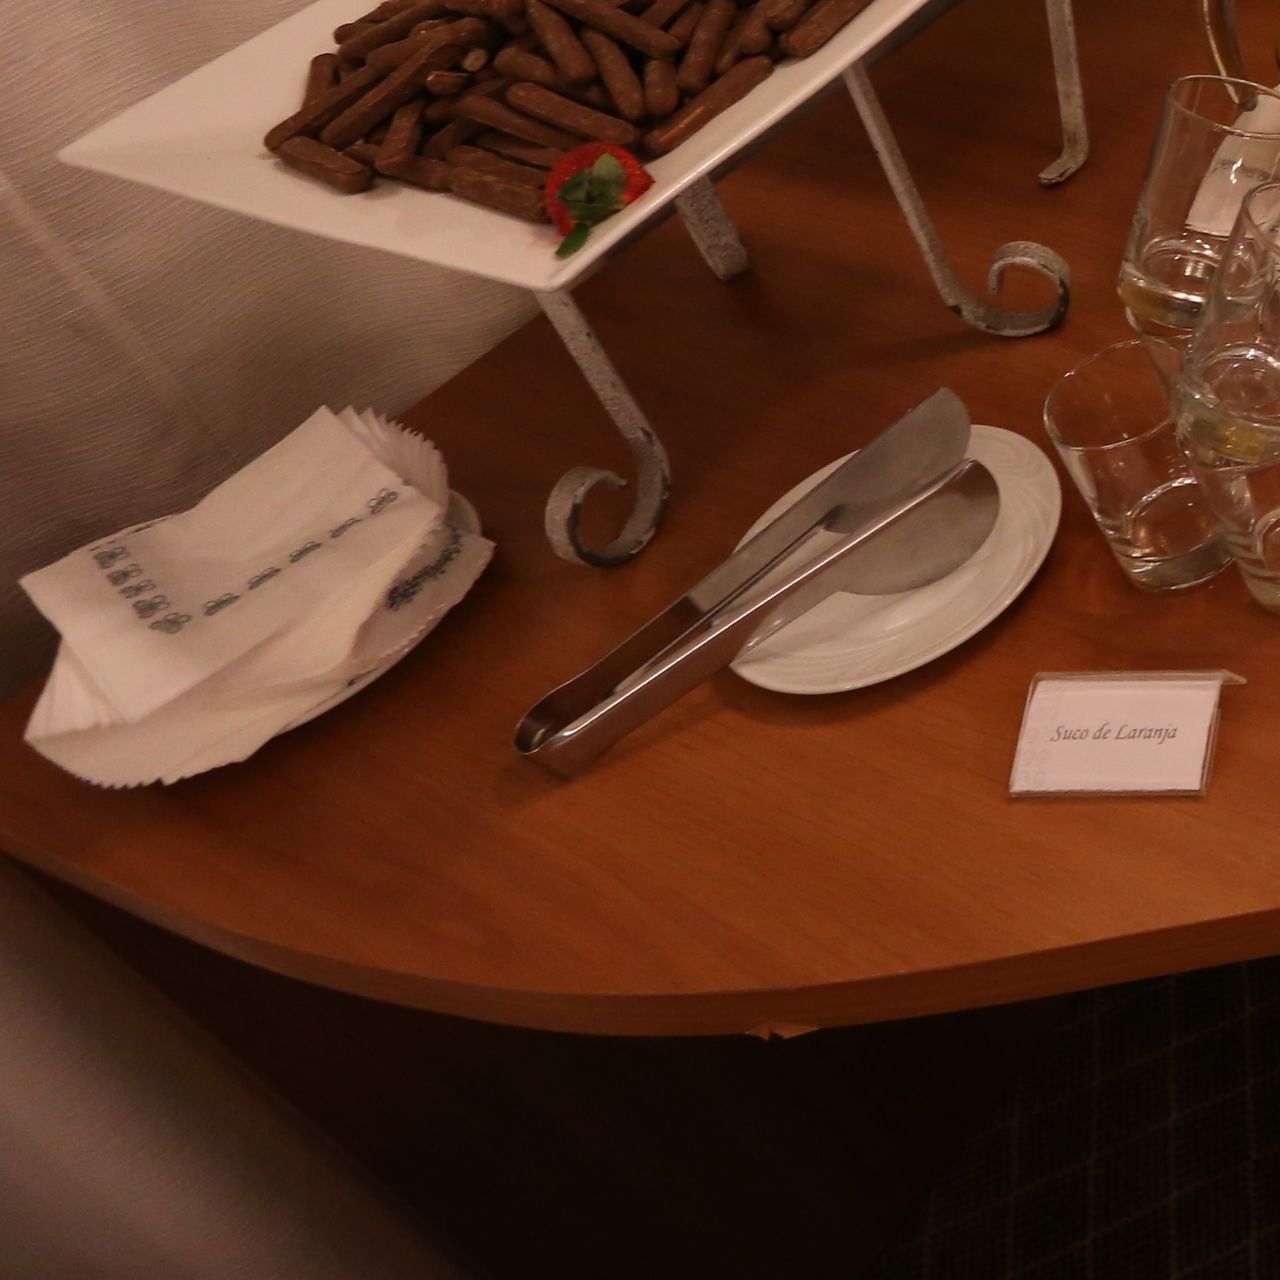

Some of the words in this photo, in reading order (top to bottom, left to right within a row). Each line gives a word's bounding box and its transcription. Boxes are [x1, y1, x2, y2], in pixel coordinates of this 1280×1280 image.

[1050, 725, 1088, 742] Suco
[1092, 722, 1111, 740] de
[1114, 722, 1179, 745] Laranja
